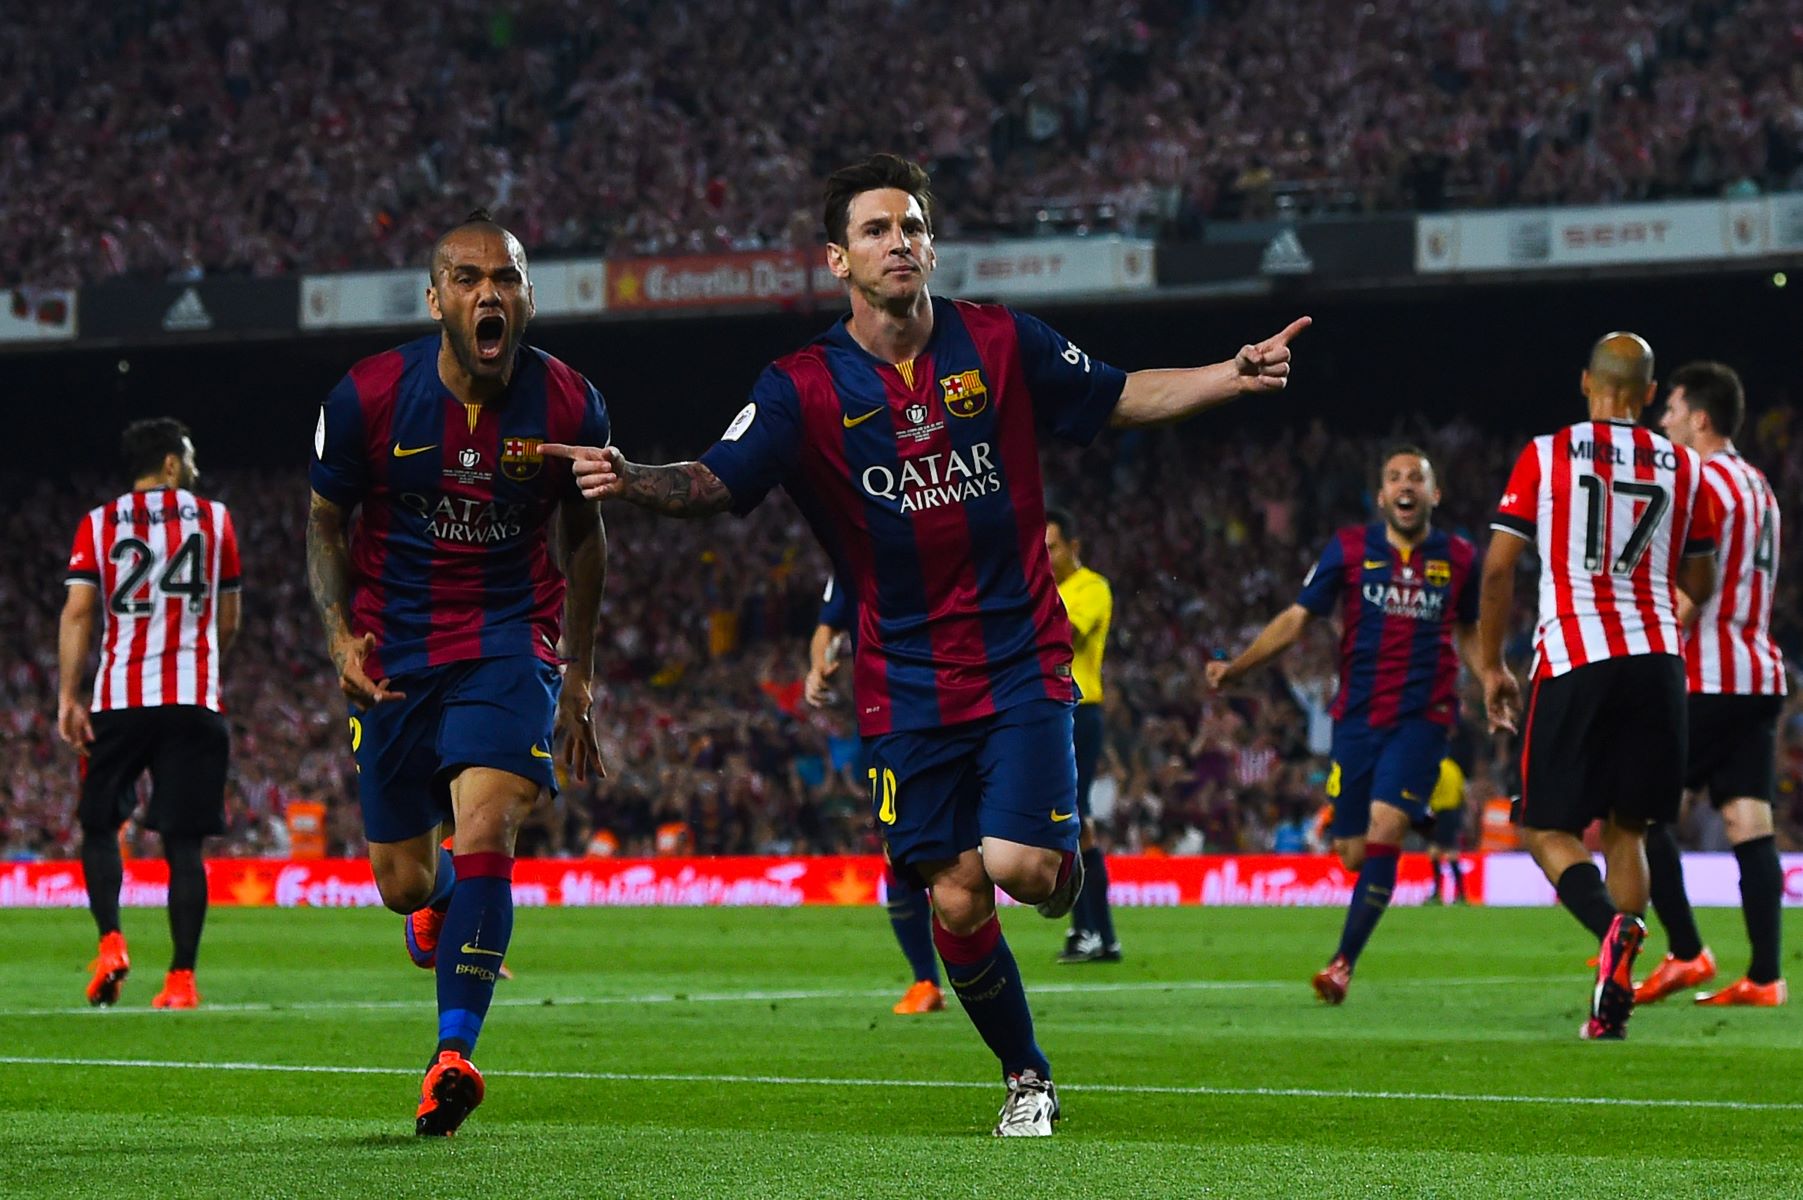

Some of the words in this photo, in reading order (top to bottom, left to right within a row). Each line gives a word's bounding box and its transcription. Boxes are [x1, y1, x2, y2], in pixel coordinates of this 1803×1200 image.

[1564, 220, 1668, 248] SEAT
[861, 441, 996, 501] QATAR
[1568, 440, 1626, 465] MIKEL
[1633, 446, 1680, 472] RICO
[900, 471, 1001, 514] AIRWAYS
[423, 519, 522, 544] AIRWAYS
[1578, 473, 1672, 575] 17
[109, 532, 210, 614] 24
[1362, 582, 1444, 609] QATAR
[868, 767, 897, 826] 10
